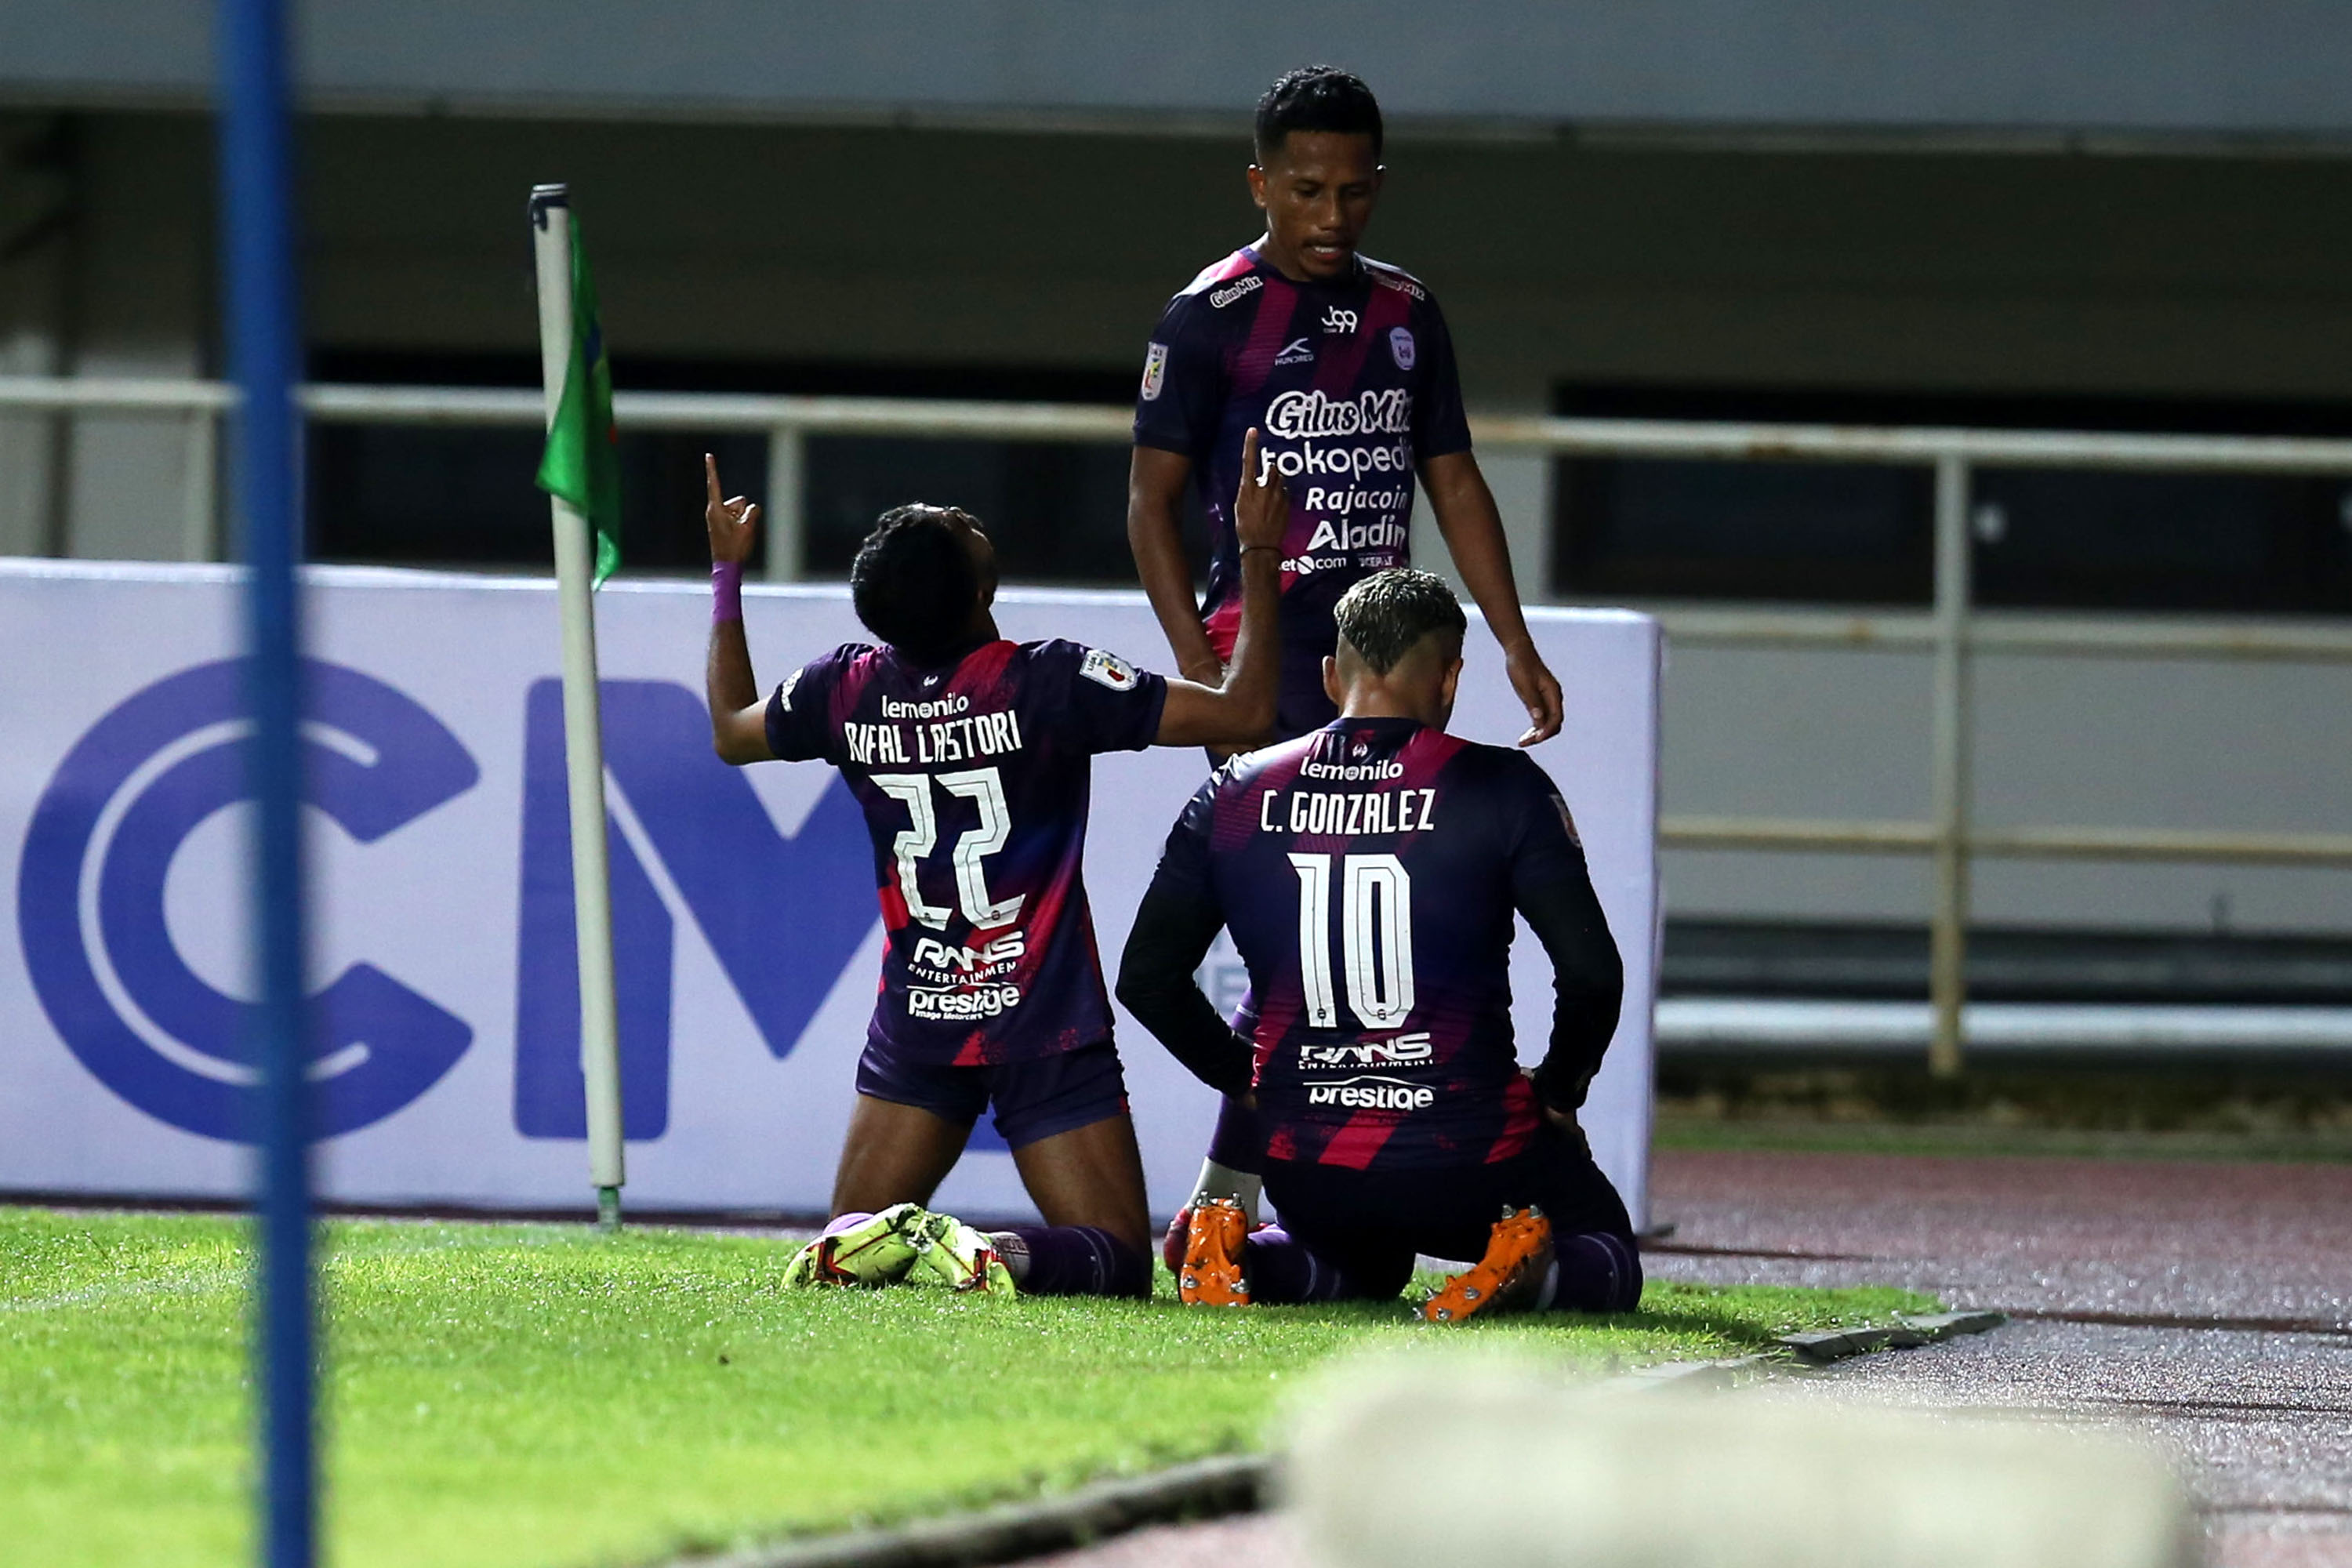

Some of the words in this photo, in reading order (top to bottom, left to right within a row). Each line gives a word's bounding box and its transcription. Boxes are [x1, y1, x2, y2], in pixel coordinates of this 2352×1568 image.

[1275, 354, 1314, 366] HUNDRED
[1255, 436, 1411, 488] tokoped
[1305, 484, 1409, 515] Rajacoin
[1305, 514, 1406, 551] Aladin
[844, 721, 911, 764] RIFAL
[916, 710, 1022, 763] LASTORI
[1299, 757, 1404, 781] lemonilo
[1261, 789, 1283, 833] C.
[1289, 788, 1436, 835] GONZALEZ
[869, 766, 1026, 931] 22
[1287, 852, 1414, 1029] 10
[907, 961, 1018, 985] ENTERTAINMEN
[909, 985, 1020, 1016] prestige
[1300, 1032, 1433, 1064] RANS
[1308, 1085, 1434, 1111] prestige
